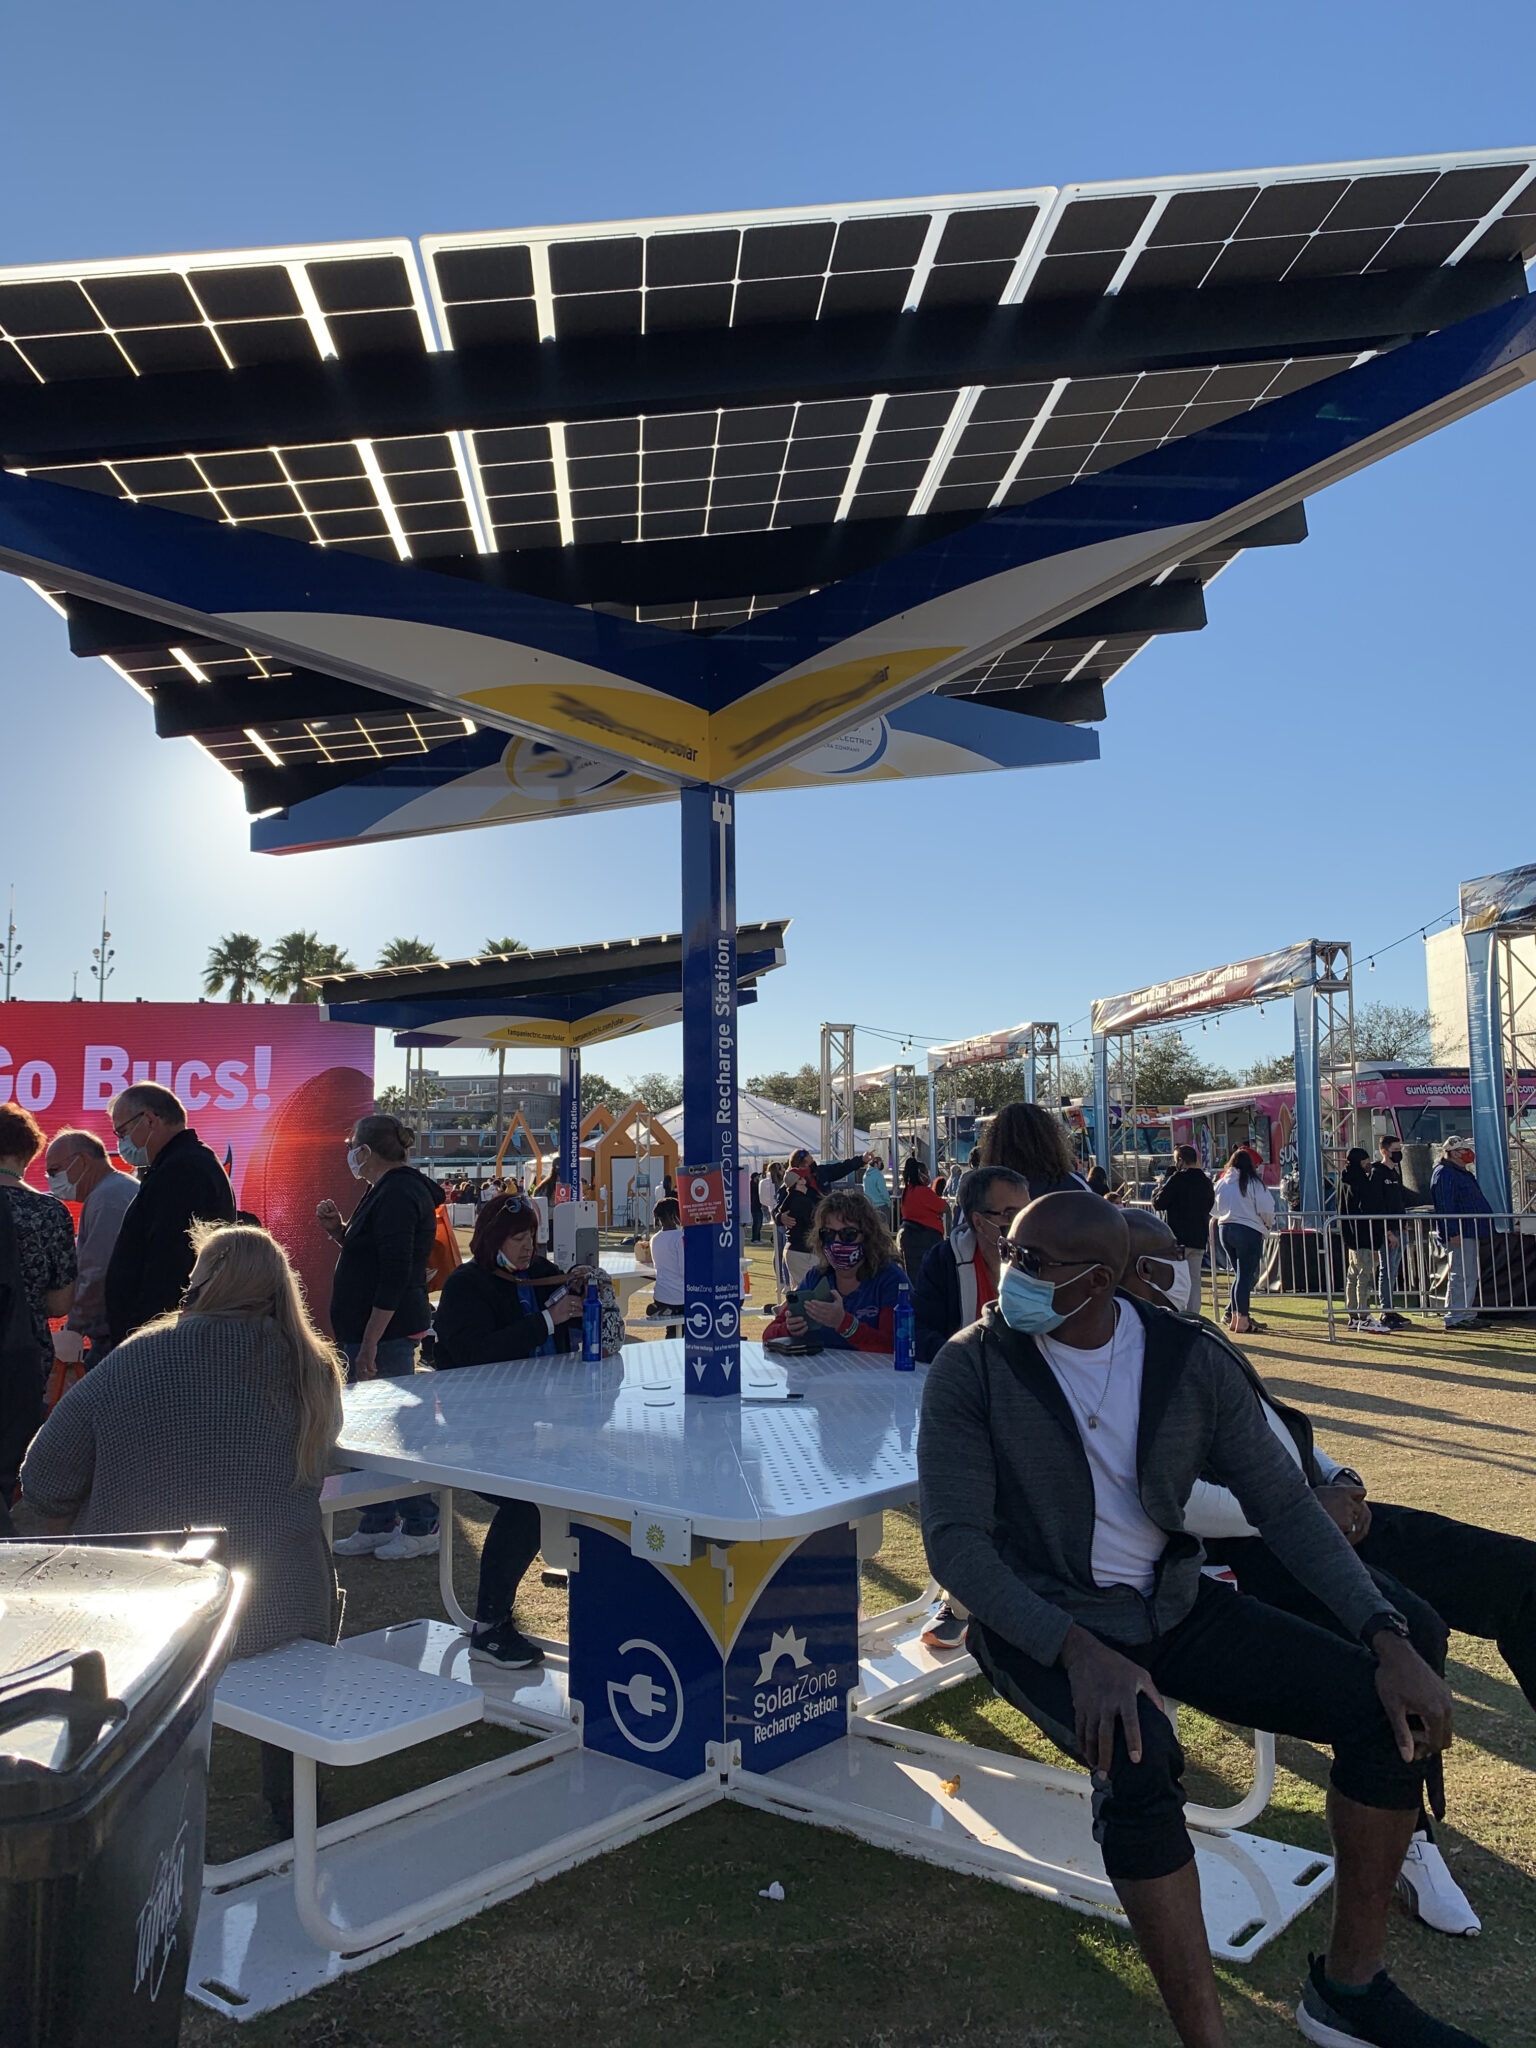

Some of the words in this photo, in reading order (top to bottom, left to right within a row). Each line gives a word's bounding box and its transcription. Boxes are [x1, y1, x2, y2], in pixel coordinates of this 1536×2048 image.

[838, 735, 873, 746] LECTRIC
[715, 939, 731, 1017] Station
[83, 1045, 272, 1111] Bucs!
[716, 1023, 734, 1124] Recharge
[753, 1668, 837, 1719] SolarZone
[754, 1713, 801, 1745] Recharge
[803, 1695, 838, 1722] Station
